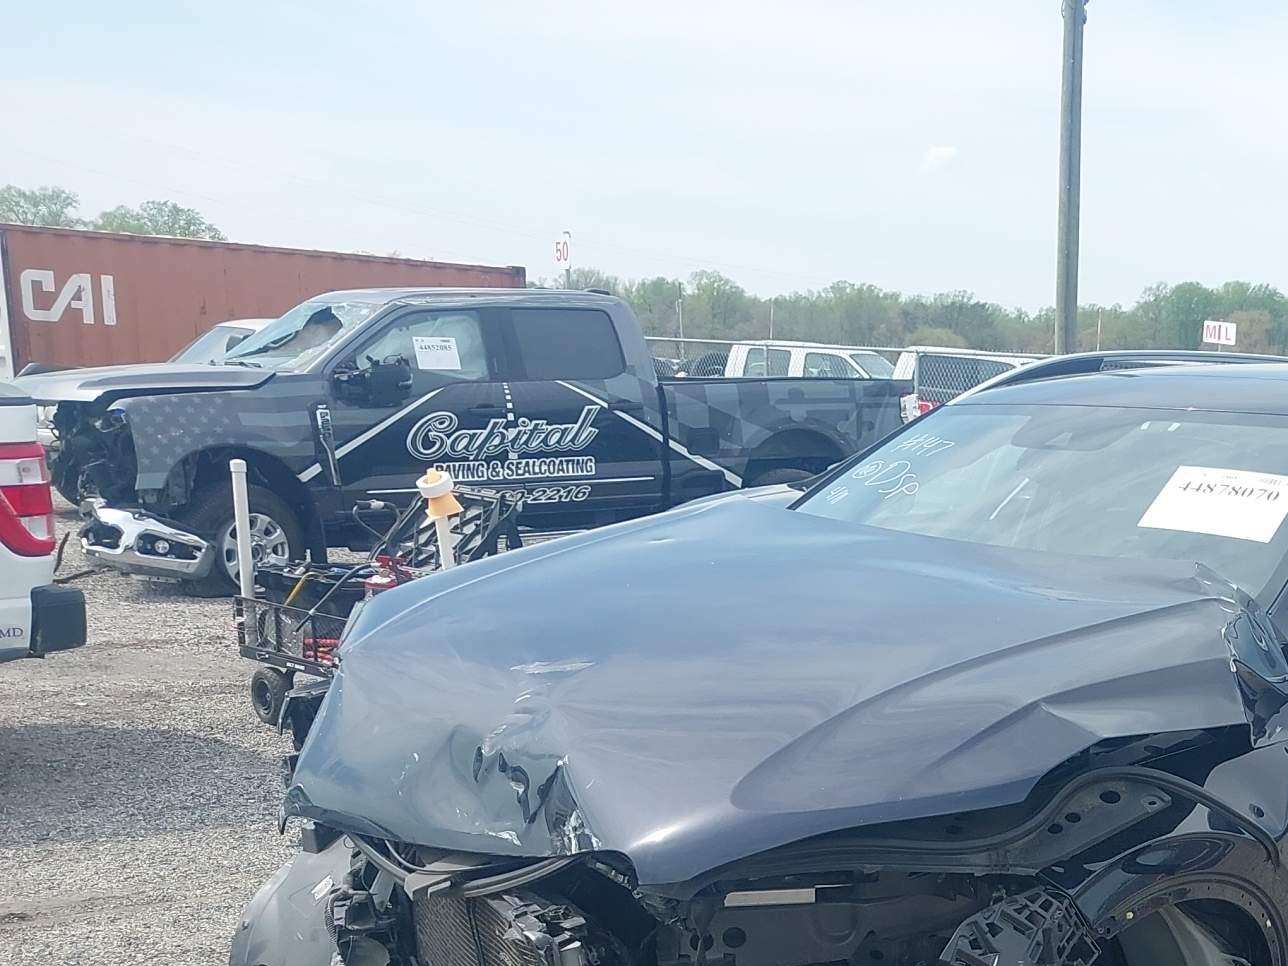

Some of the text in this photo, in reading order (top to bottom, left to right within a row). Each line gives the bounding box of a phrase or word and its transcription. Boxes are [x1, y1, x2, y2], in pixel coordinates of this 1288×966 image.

[555, 241, 569, 262] 50
[20, 268, 117, 326] CAI
[406, 405, 601, 460] Capital
[489, 461, 504, 480] &
[504, 456, 595, 479] SEALCOATING
[1178, 480, 1281, 501] 44878070
